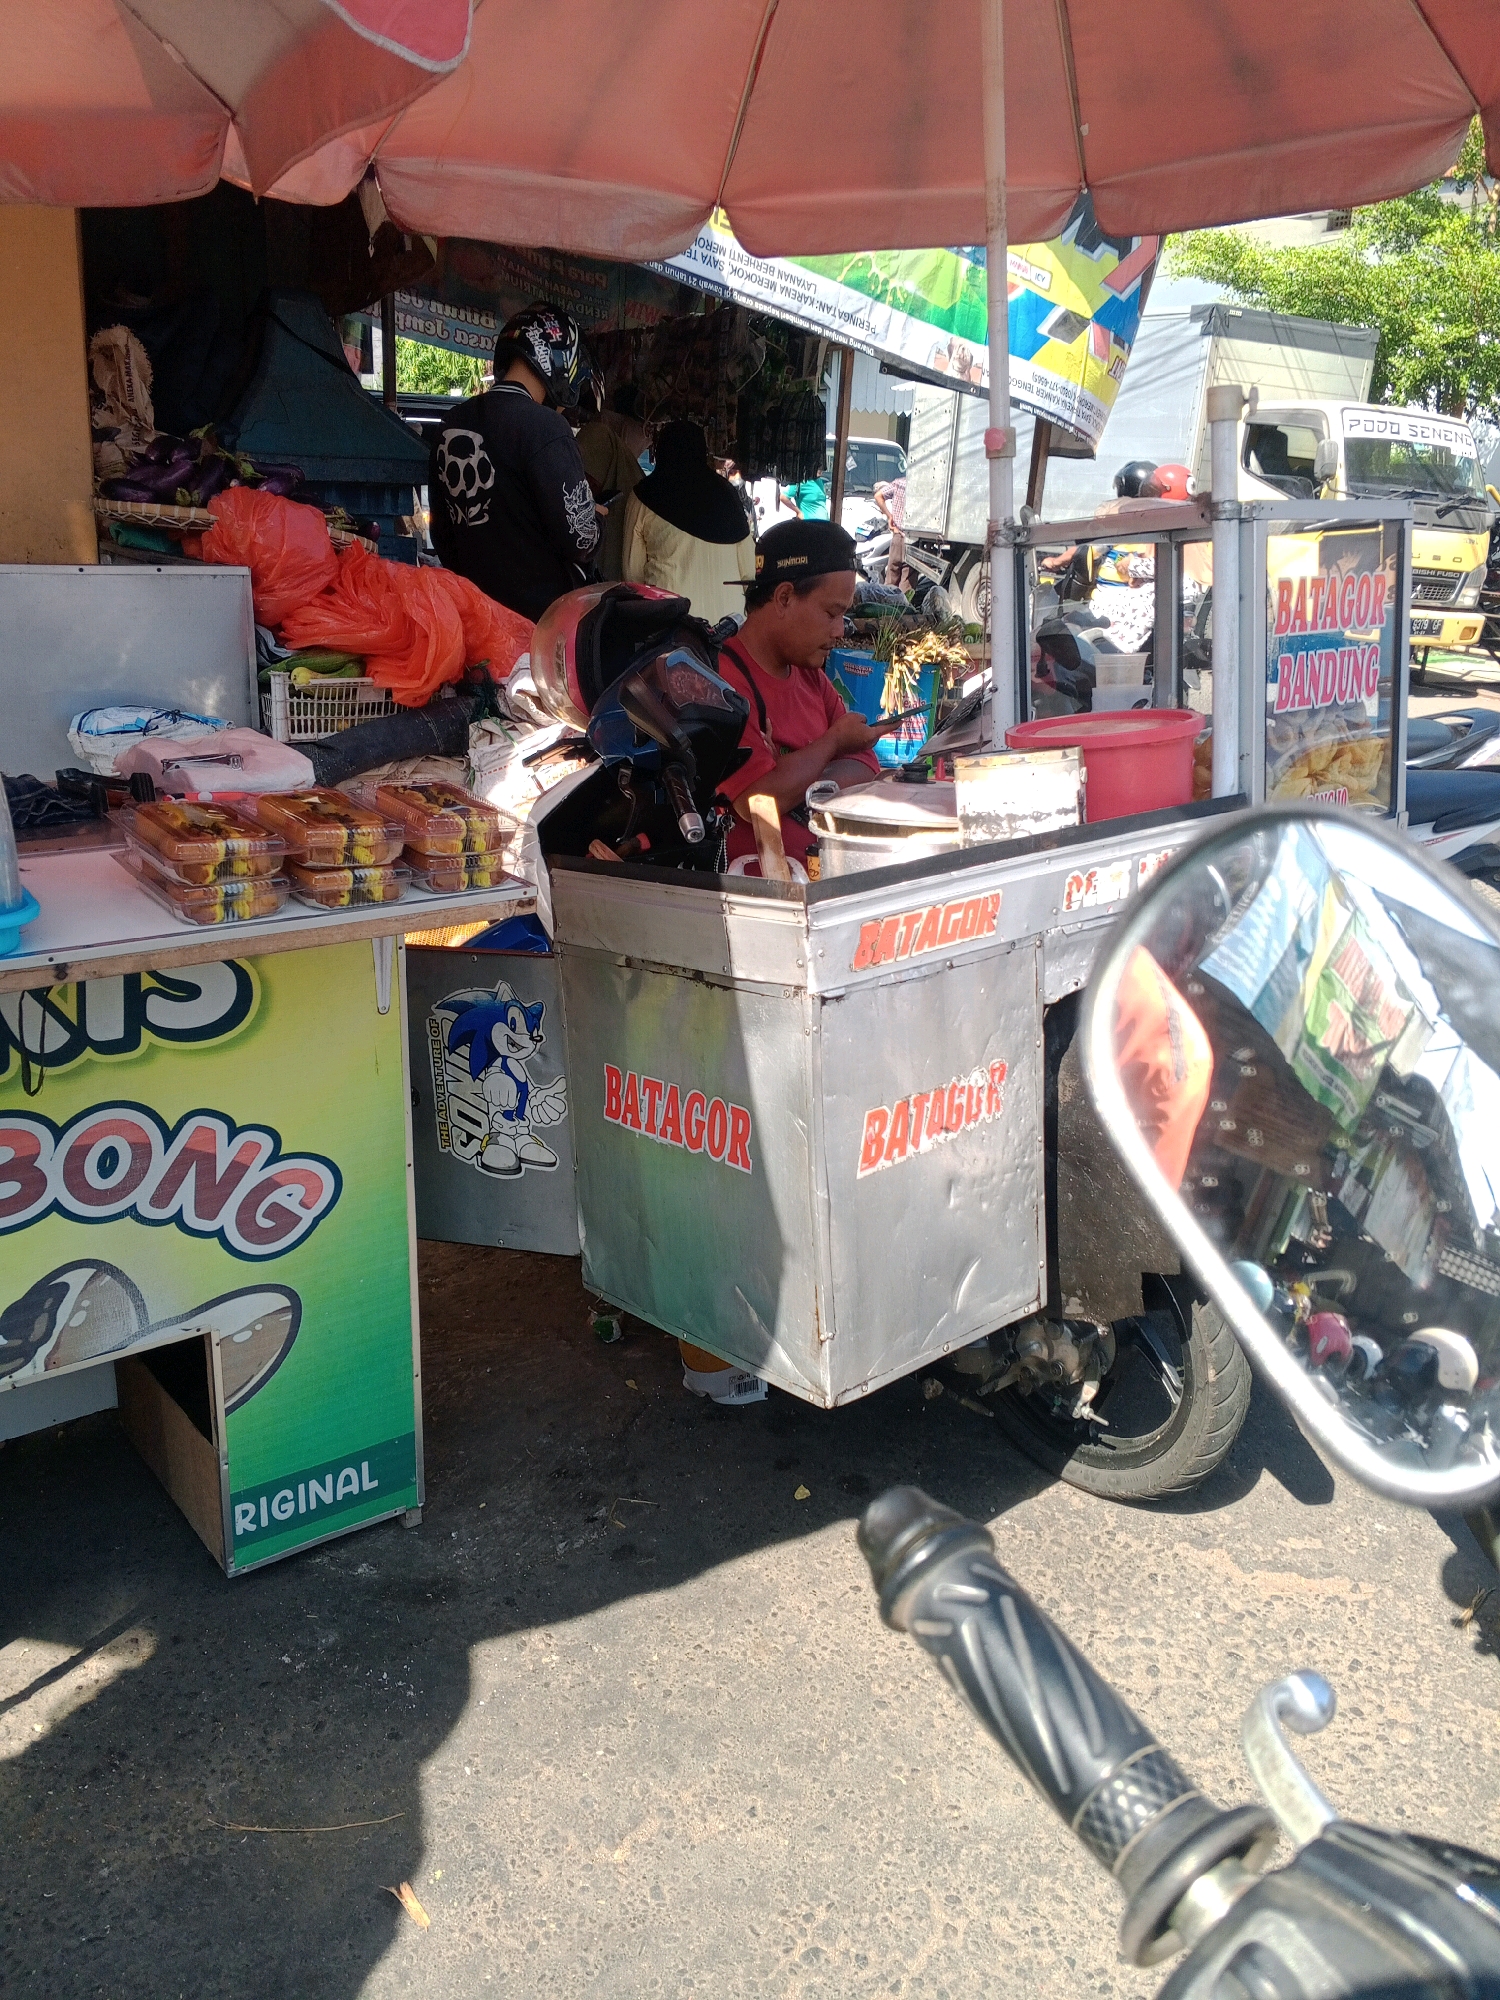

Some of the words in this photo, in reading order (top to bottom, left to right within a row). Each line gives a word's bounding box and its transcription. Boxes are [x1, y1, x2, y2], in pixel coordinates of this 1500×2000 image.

[700, 253, 725, 272] SAYA
[729, 248, 775, 276] BERHENTI
[664, 266, 688, 283] tahun
[688, 275, 698, 287] 21
[728, 262, 777, 294] MEROKOK,
[777, 271, 817, 294] LAYANAN
[699, 280, 725, 297] bawah
[732, 291, 753, 307] orang
[779, 284, 816, 309] KARENA
[810, 322, 823, 336] dan
[815, 300, 877, 335] PERINGATAN:
[849, 337, 874, 357] Dilarang
[1349, 419, 1401, 436] PODO
[1437, 570, 1460, 578] FUSO
[1273, 571, 1386, 637] BATAGOR
[1273, 643, 1381, 714] BANDUNG
[852, 889, 1003, 971] BATAGOR
[428, 1018, 441, 1038] OF
[430, 1039, 447, 1120] ADVENTURE
[603, 1063, 752, 1174] BATAGOR
[856, 1058, 1008, 1180] BATAGOR
[438, 1120, 451, 1149] THE
